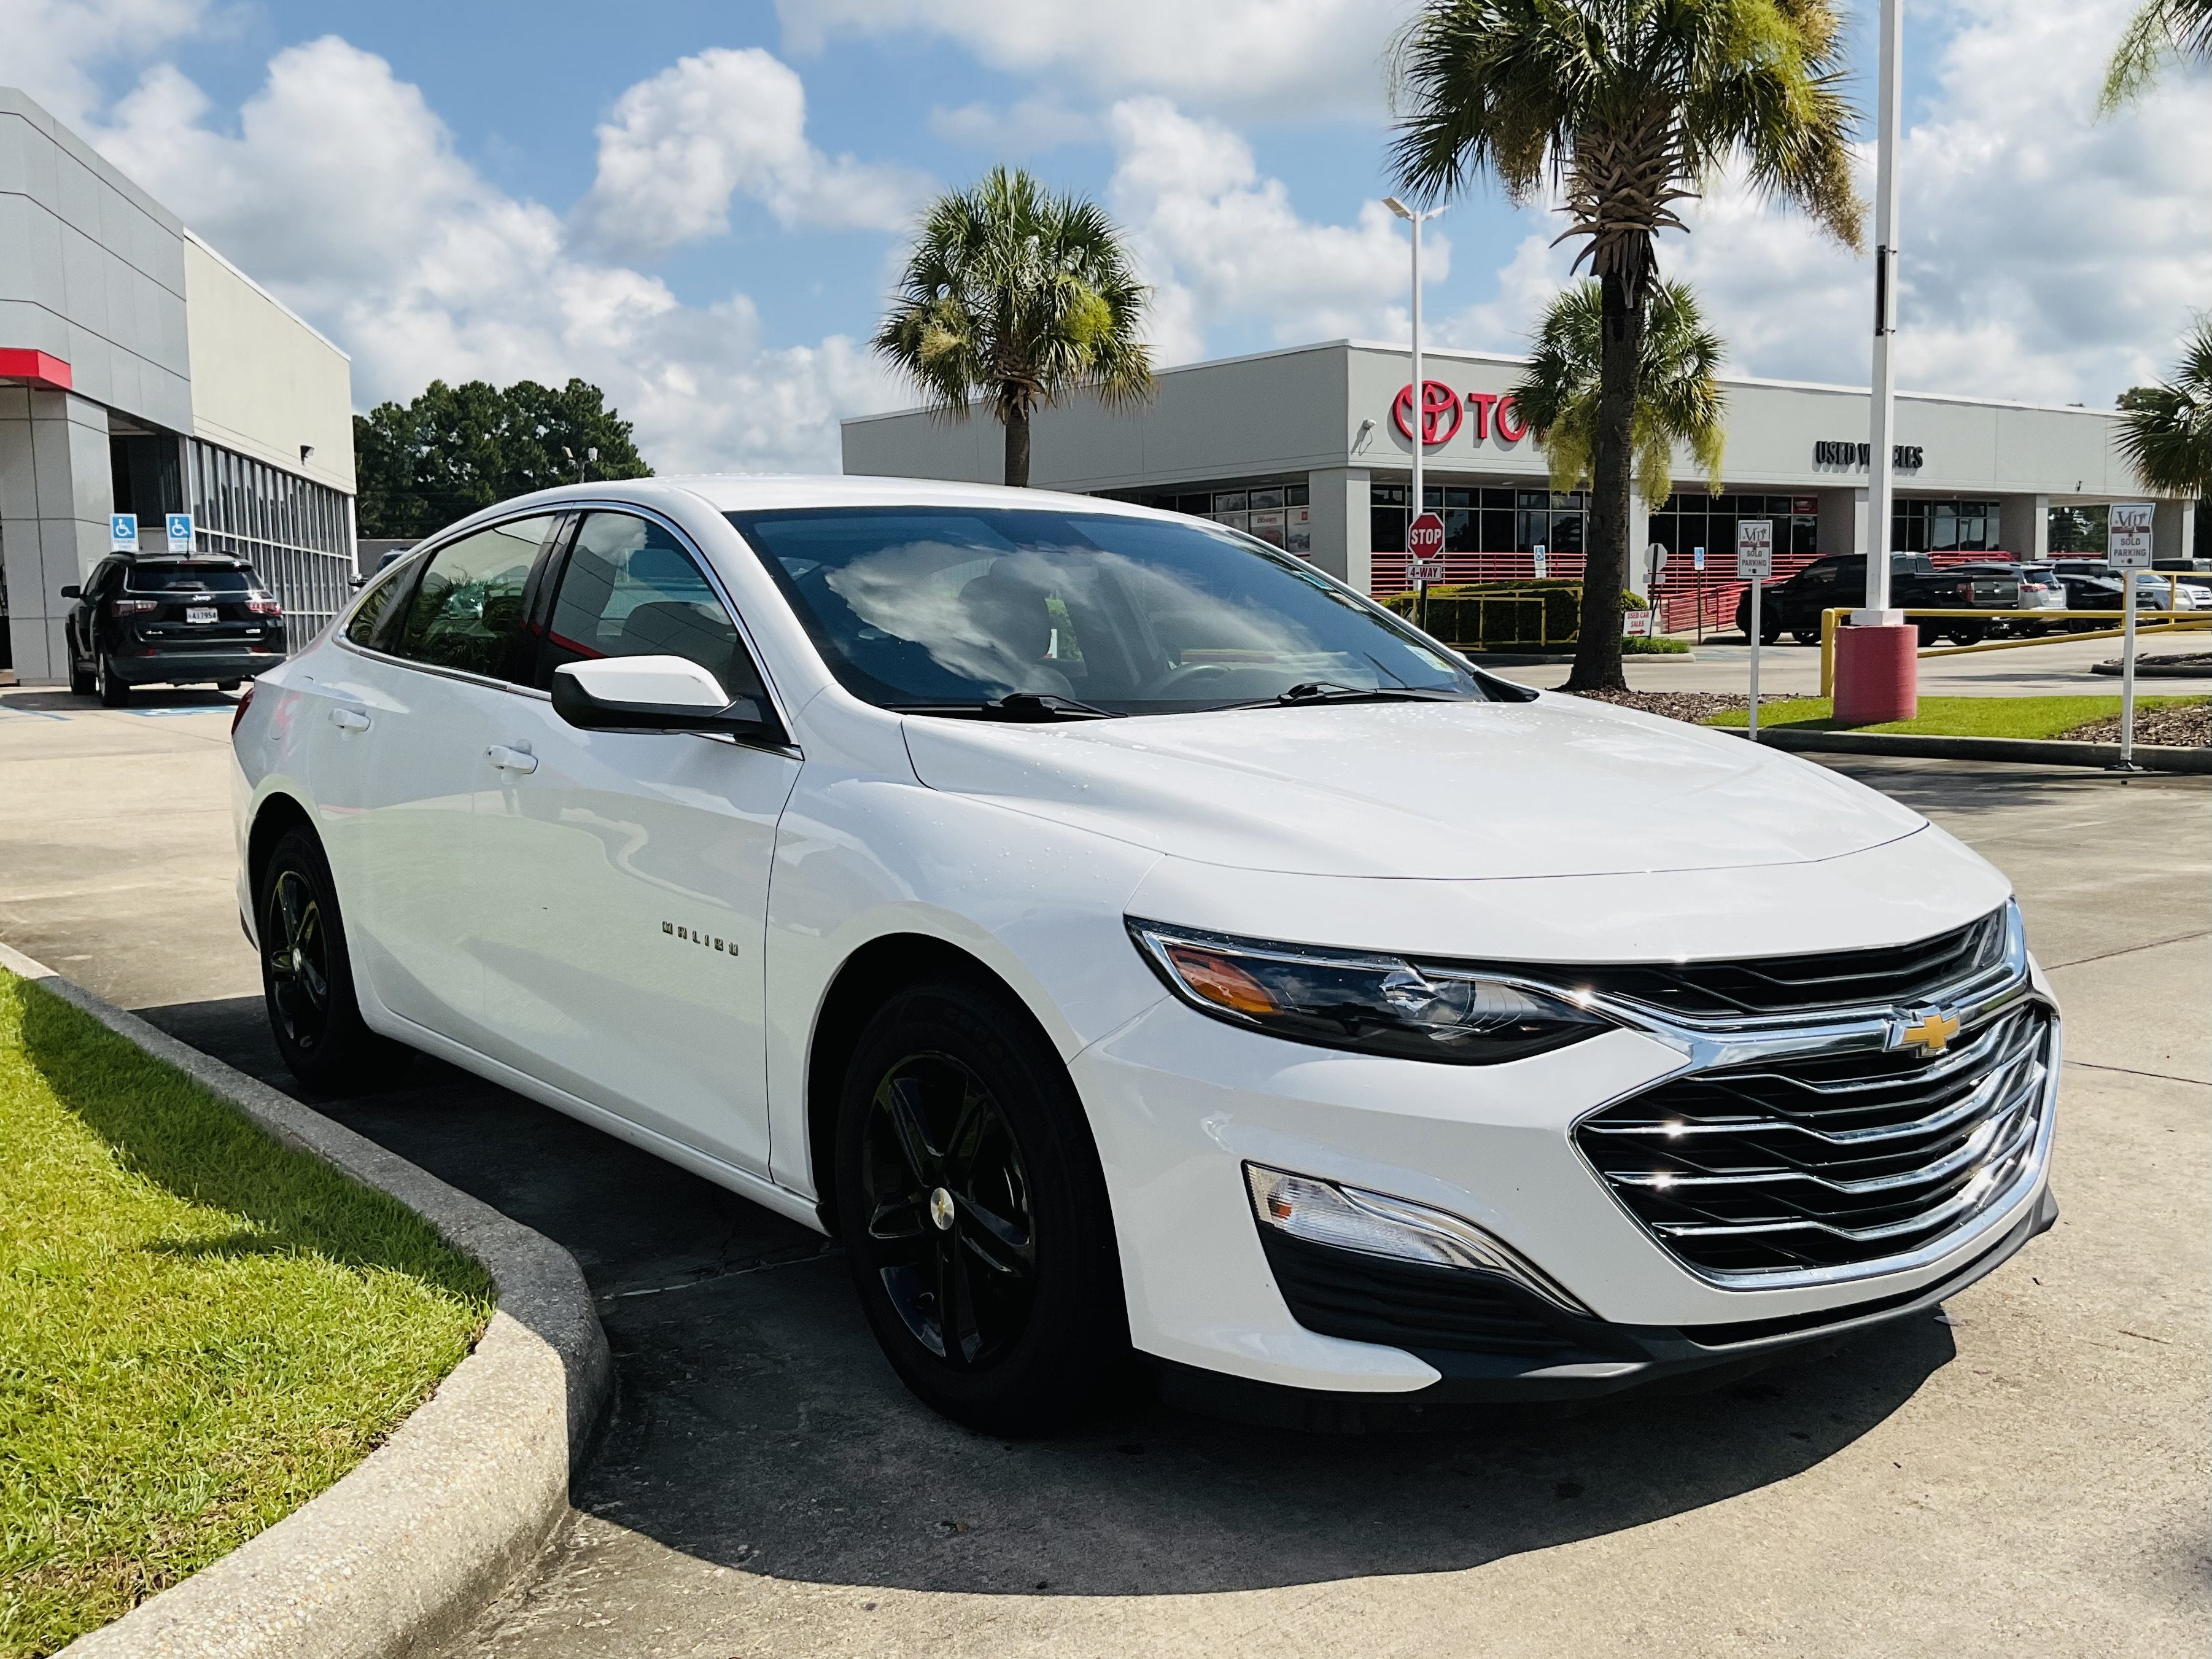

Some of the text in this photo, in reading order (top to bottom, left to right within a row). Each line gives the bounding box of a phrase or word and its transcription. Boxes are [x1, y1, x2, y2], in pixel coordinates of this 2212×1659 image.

[1816, 441, 1923, 468] USED VCLES
[1411, 529, 1442, 545] STOP
[1410, 567, 1438, 578] 4-WAY
[662, 920, 739, 957] MALIBU
